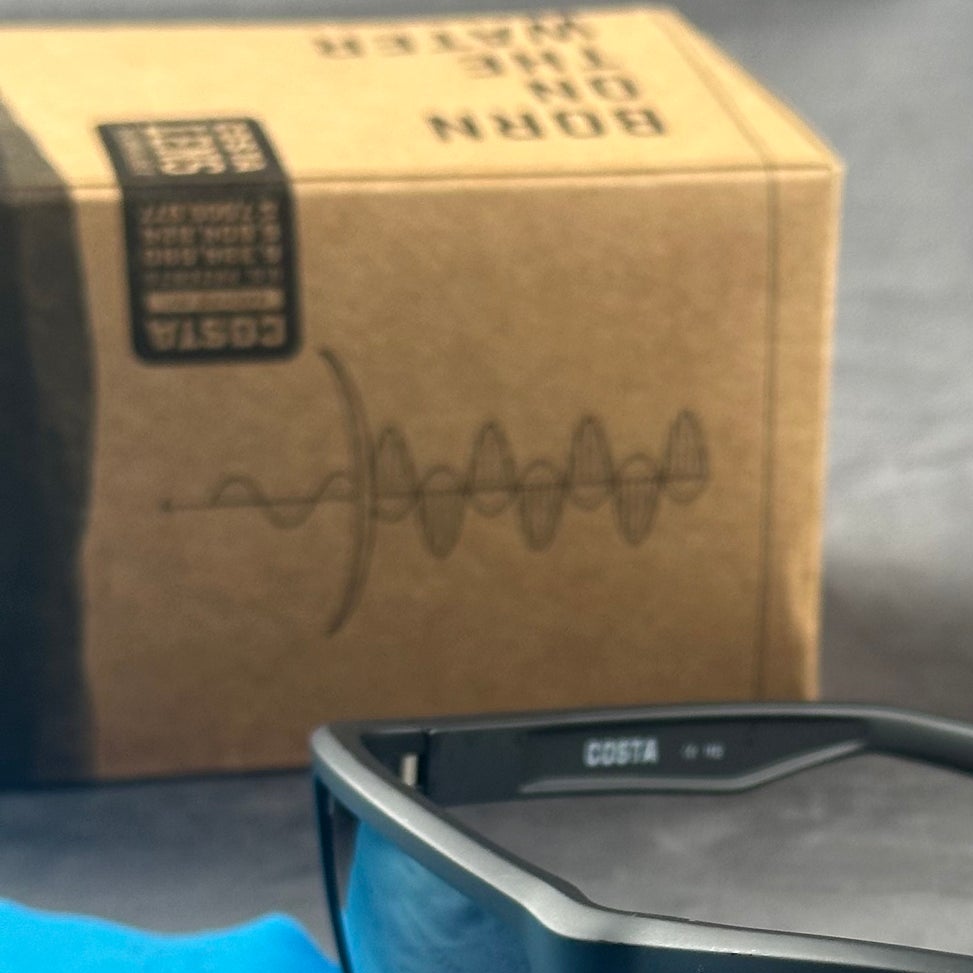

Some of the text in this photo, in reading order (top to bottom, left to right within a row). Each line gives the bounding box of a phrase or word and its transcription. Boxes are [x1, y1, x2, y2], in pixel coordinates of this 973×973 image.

[312, 12, 600, 59] WATER
[459, 48, 620, 79] THE
[523, 75, 640, 101] ON
[425, 106, 668, 142] BORN
[148, 316, 286, 351] COSTA
[583, 736, 660, 767] COSTA
